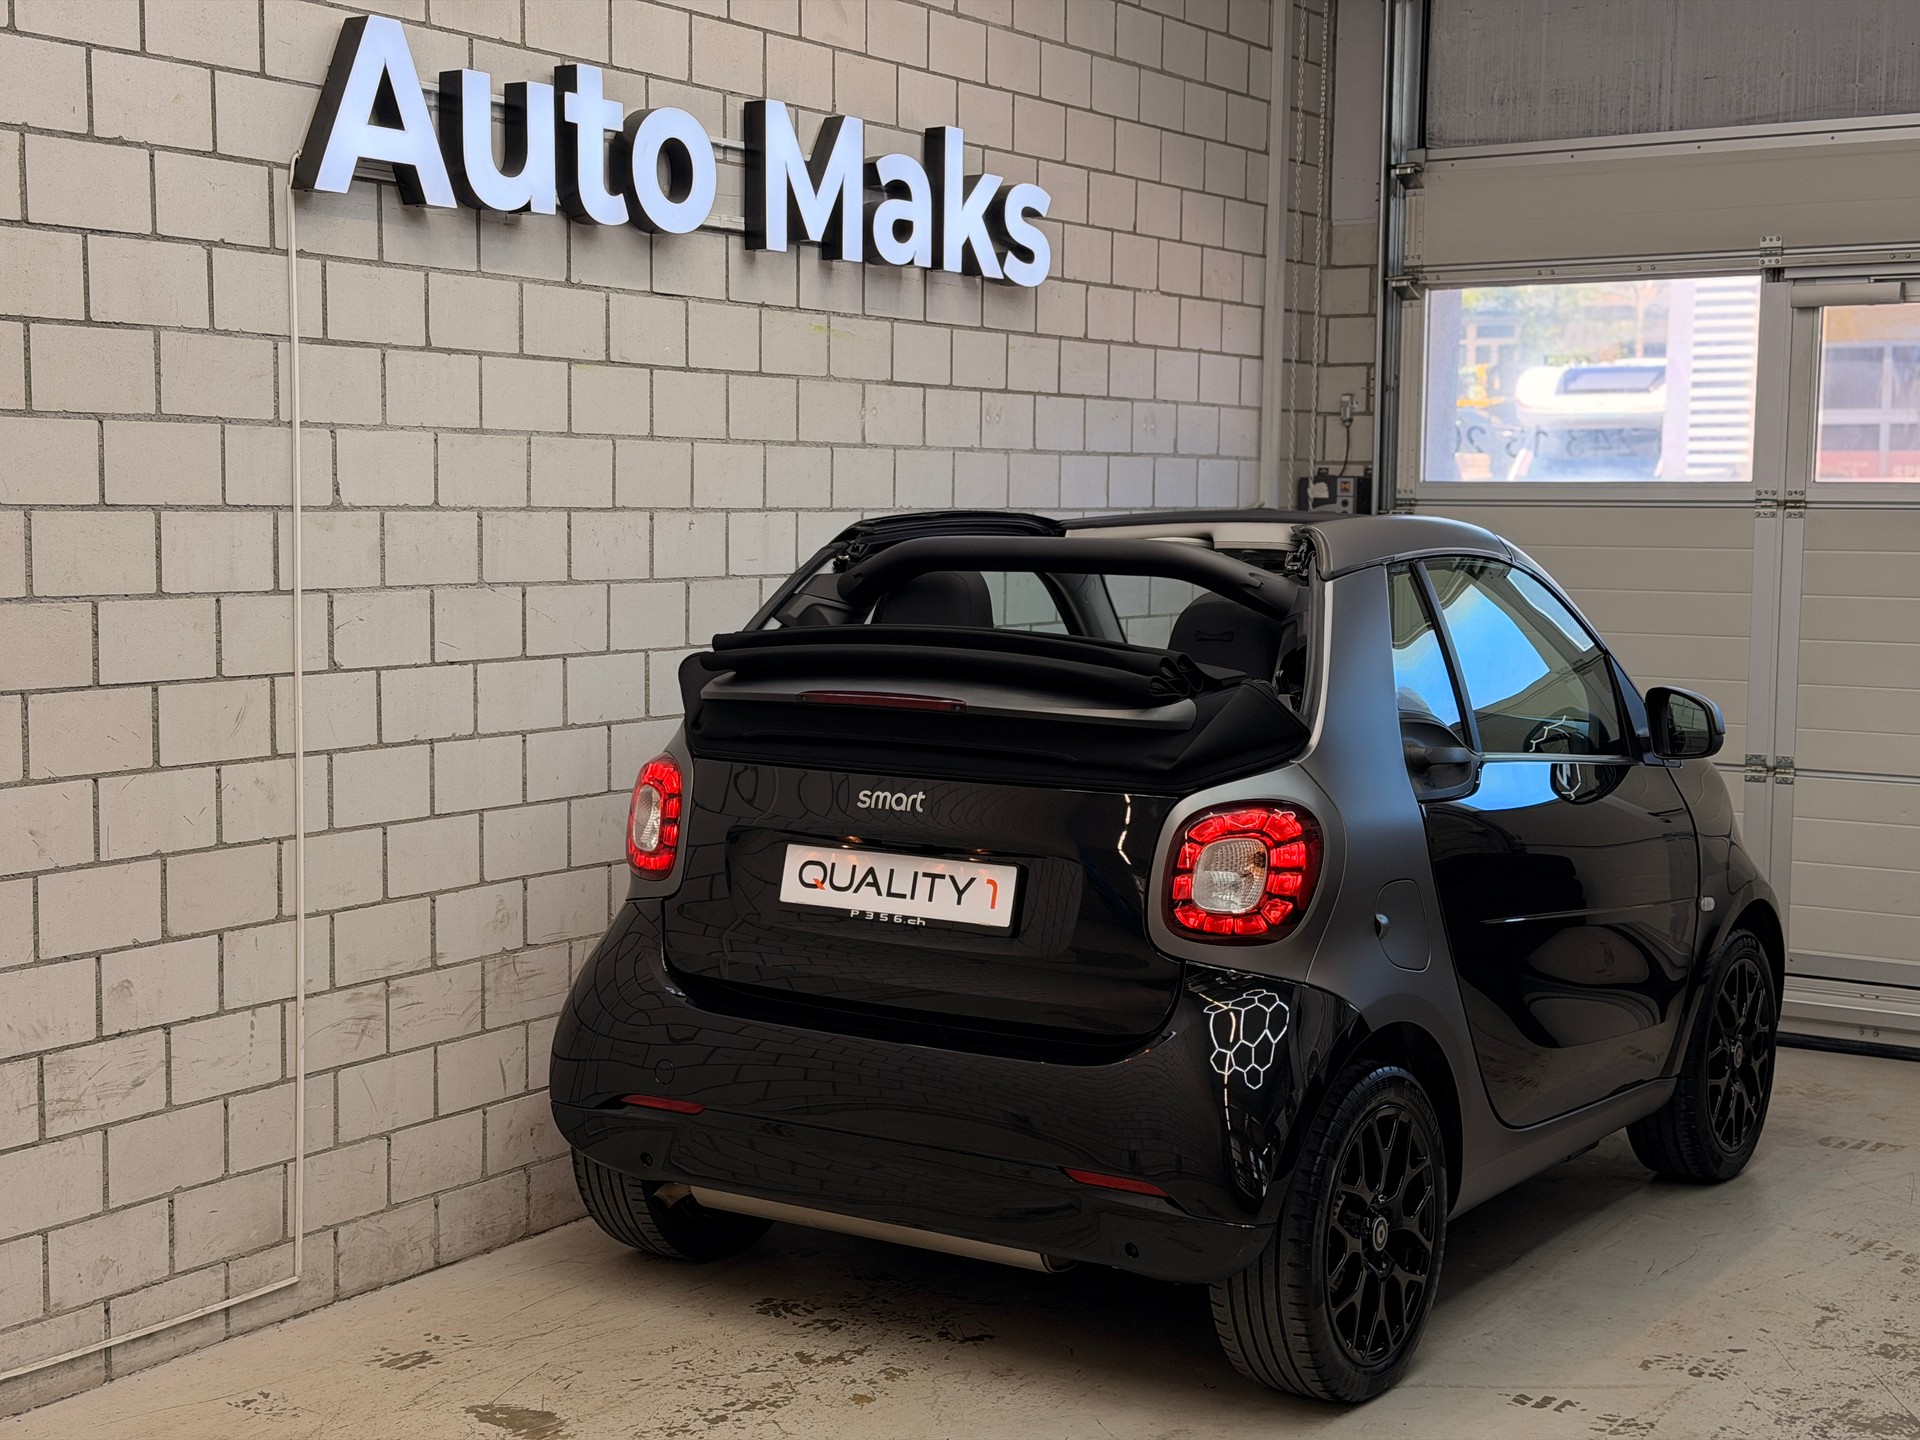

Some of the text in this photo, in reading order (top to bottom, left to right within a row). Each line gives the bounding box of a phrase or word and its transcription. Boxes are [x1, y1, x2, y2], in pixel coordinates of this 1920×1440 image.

[294, 14, 1052, 288] Auto Maks
[857, 789, 925, 812] smart
[798, 860, 998, 909] QUALITY 1
